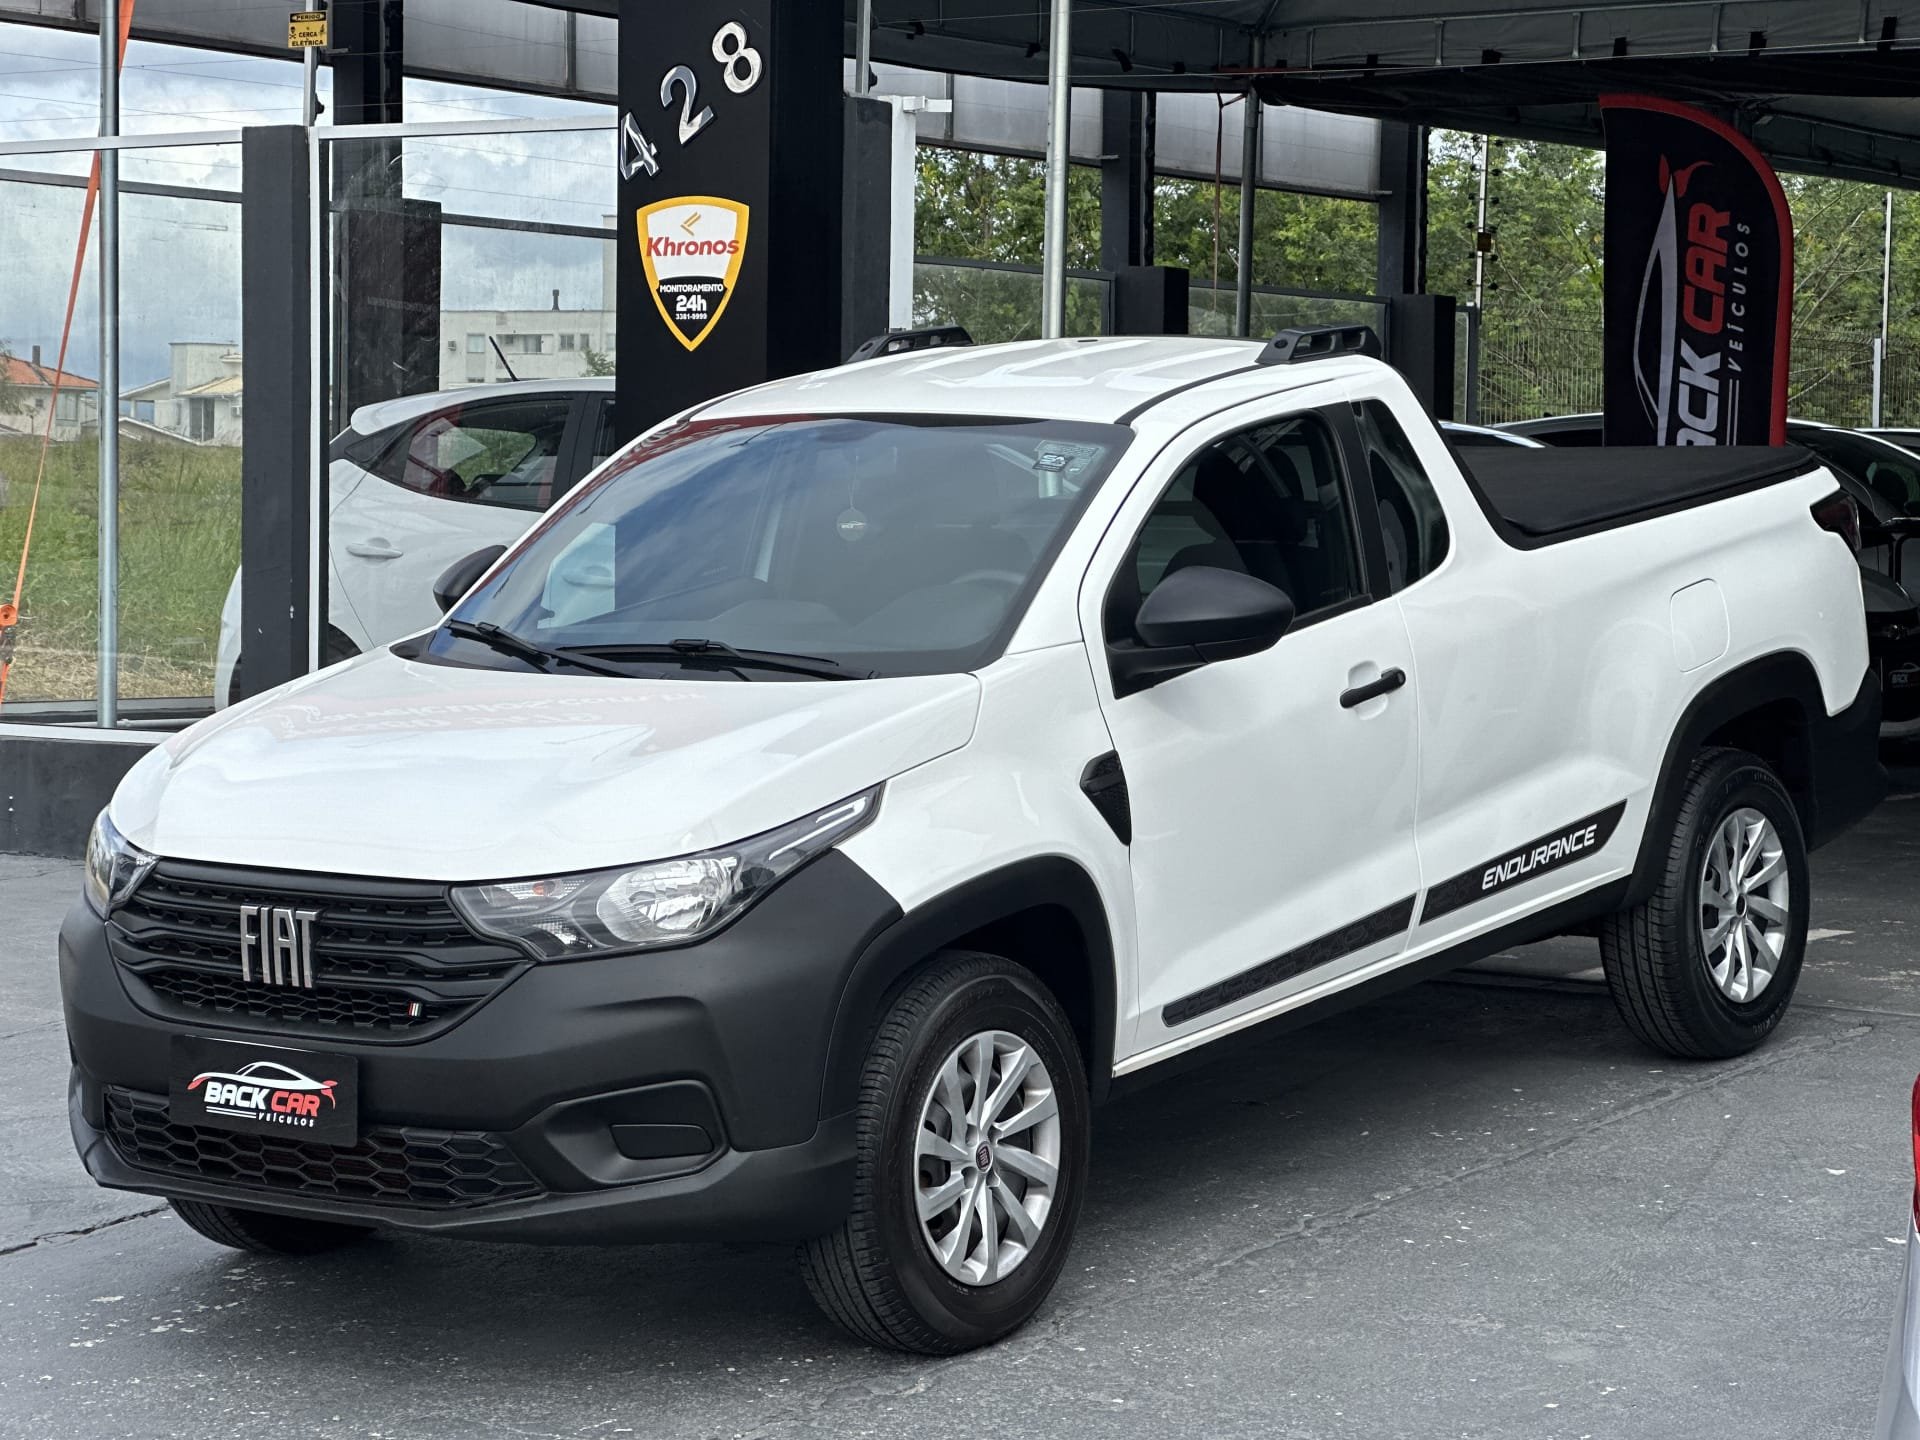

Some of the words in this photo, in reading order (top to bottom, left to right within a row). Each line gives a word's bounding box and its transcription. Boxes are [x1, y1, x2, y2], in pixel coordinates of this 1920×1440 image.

[646, 236, 740, 257] Khronos
[1683, 201, 1731, 335] CAR
[659, 283, 724, 293] MONITORAMENTO
[675, 294, 708, 312] 24h
[1482, 823, 1598, 890] ENDURANCE
[240, 904, 320, 989] FIAT
[205, 1081, 271, 1110] BACK
[270, 1090, 321, 1117] CAR
